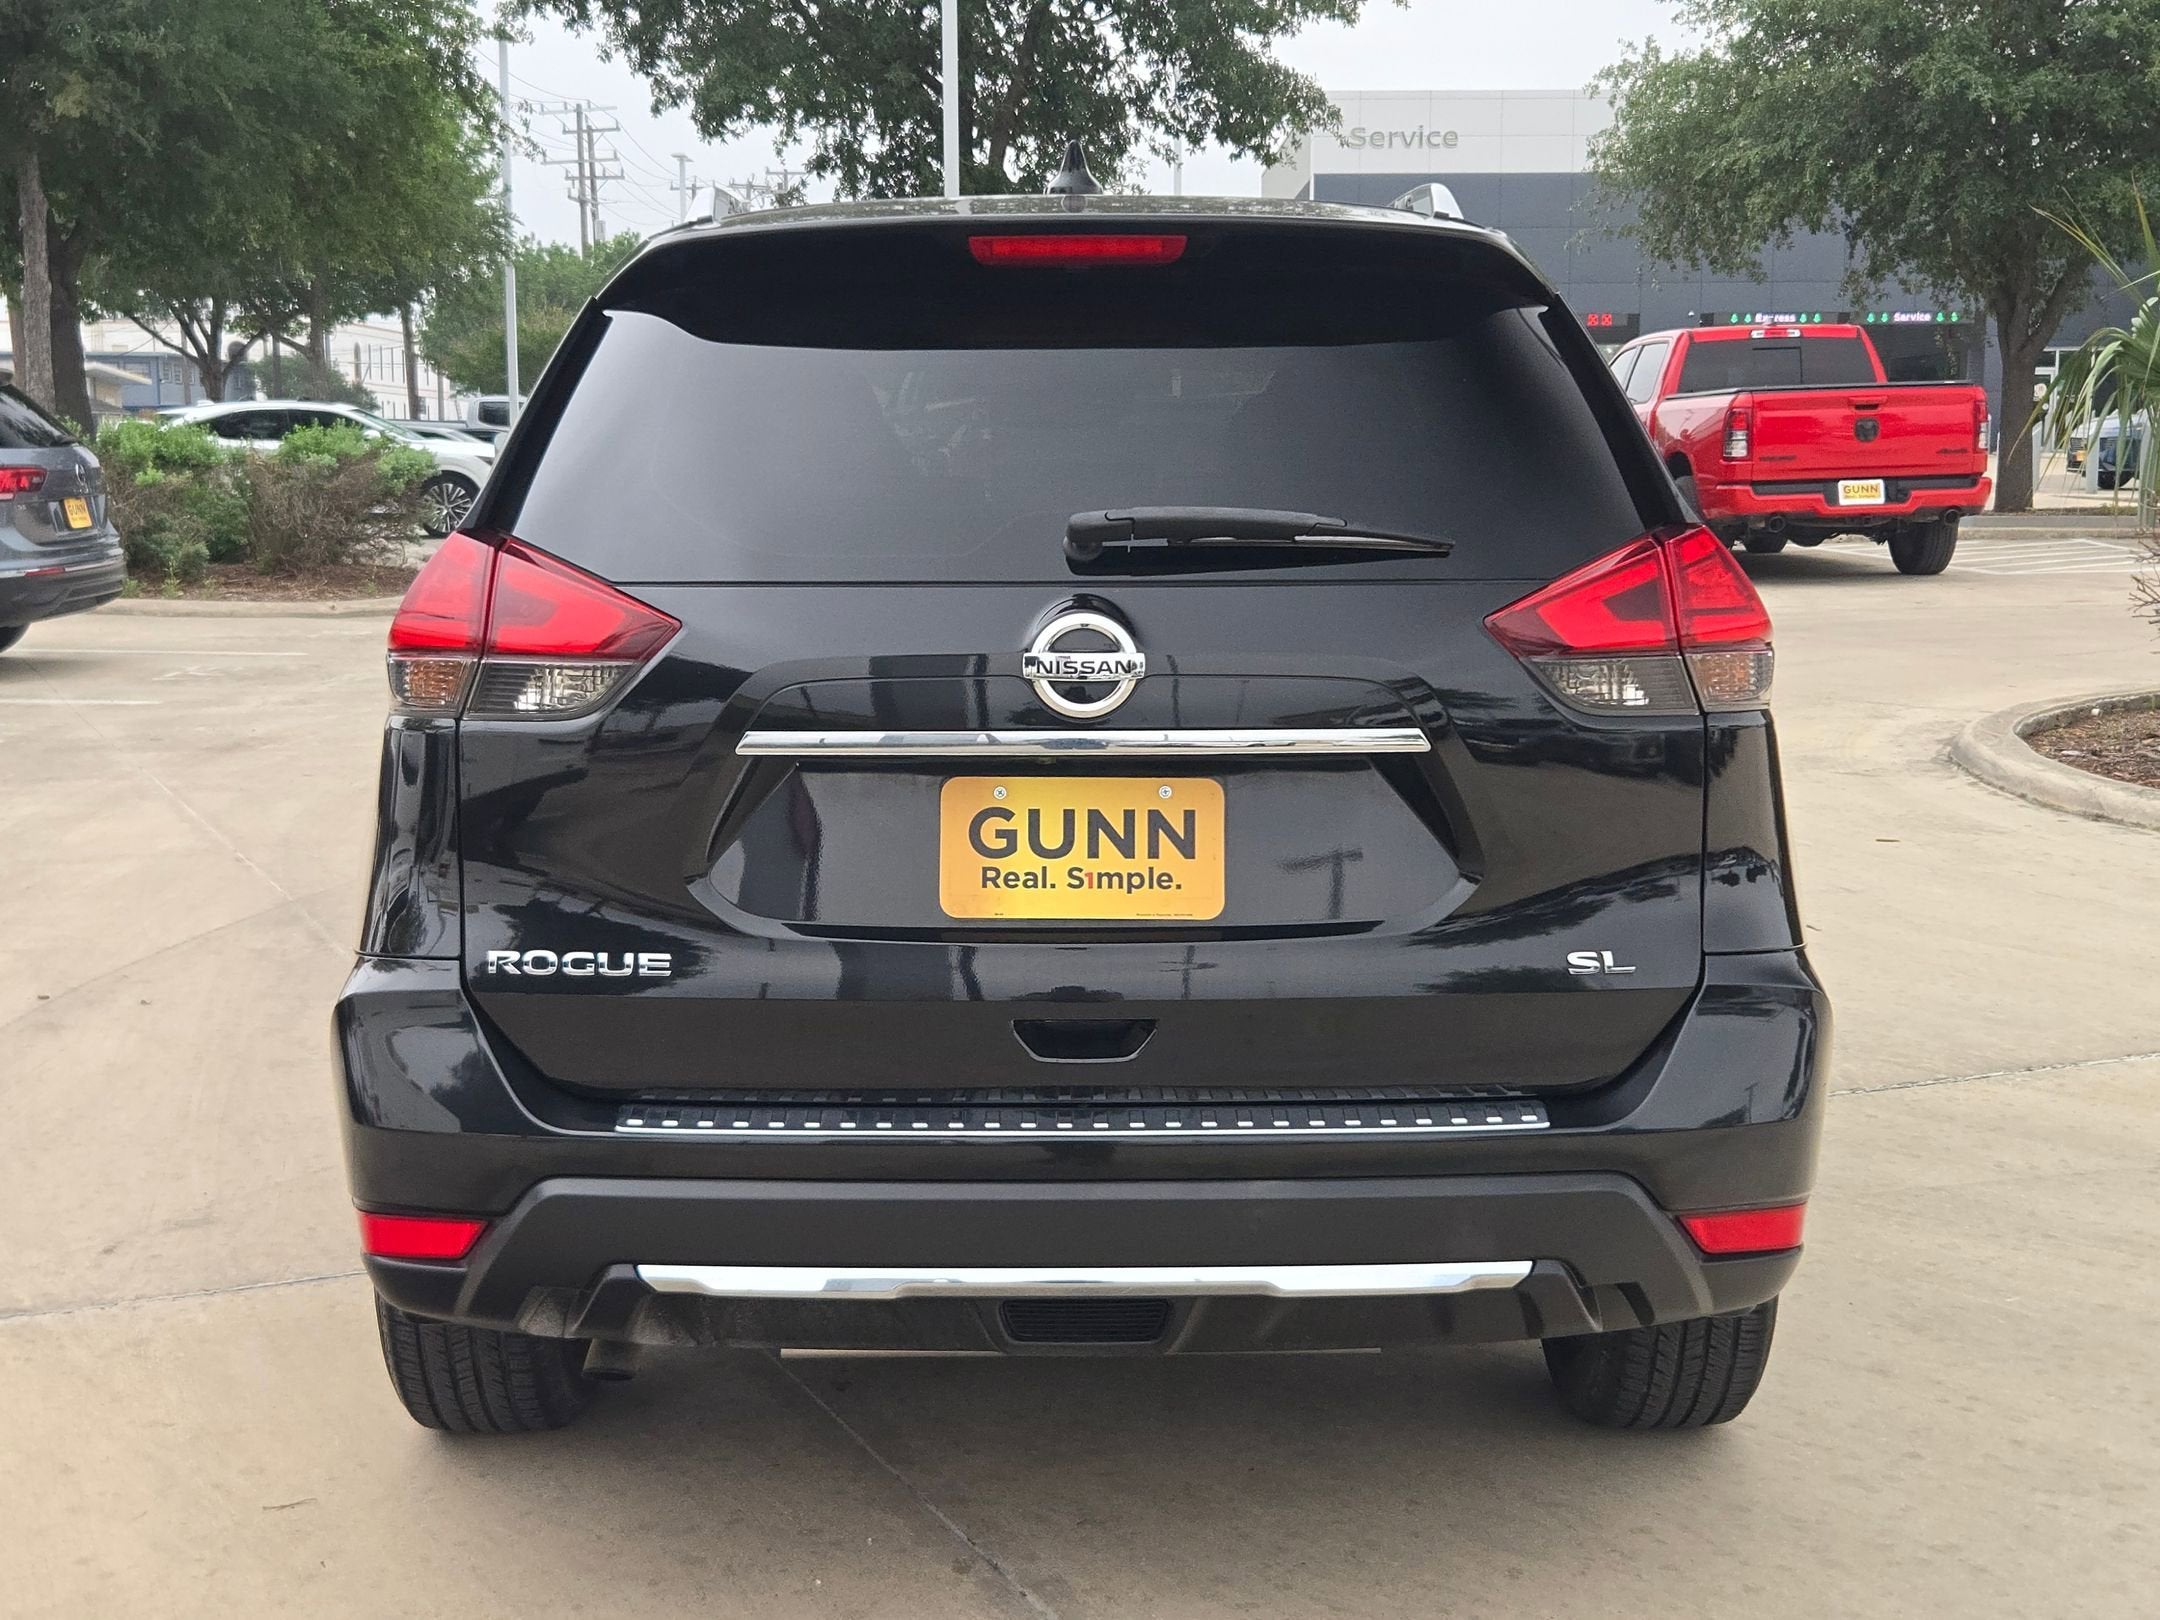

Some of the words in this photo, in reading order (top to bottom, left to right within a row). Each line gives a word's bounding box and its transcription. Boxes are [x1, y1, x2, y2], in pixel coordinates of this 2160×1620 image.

[1349, 125, 1459, 150] Service
[1893, 311, 1932, 322] Service
[1843, 484, 1879, 494] GUNN
[1036, 660, 1133, 675] NISSAN
[968, 806, 1196, 860] GUNN
[981, 866, 1056, 890] Real.
[487, 949, 672, 977] ROGUE
[1566, 951, 1637, 975] SL
